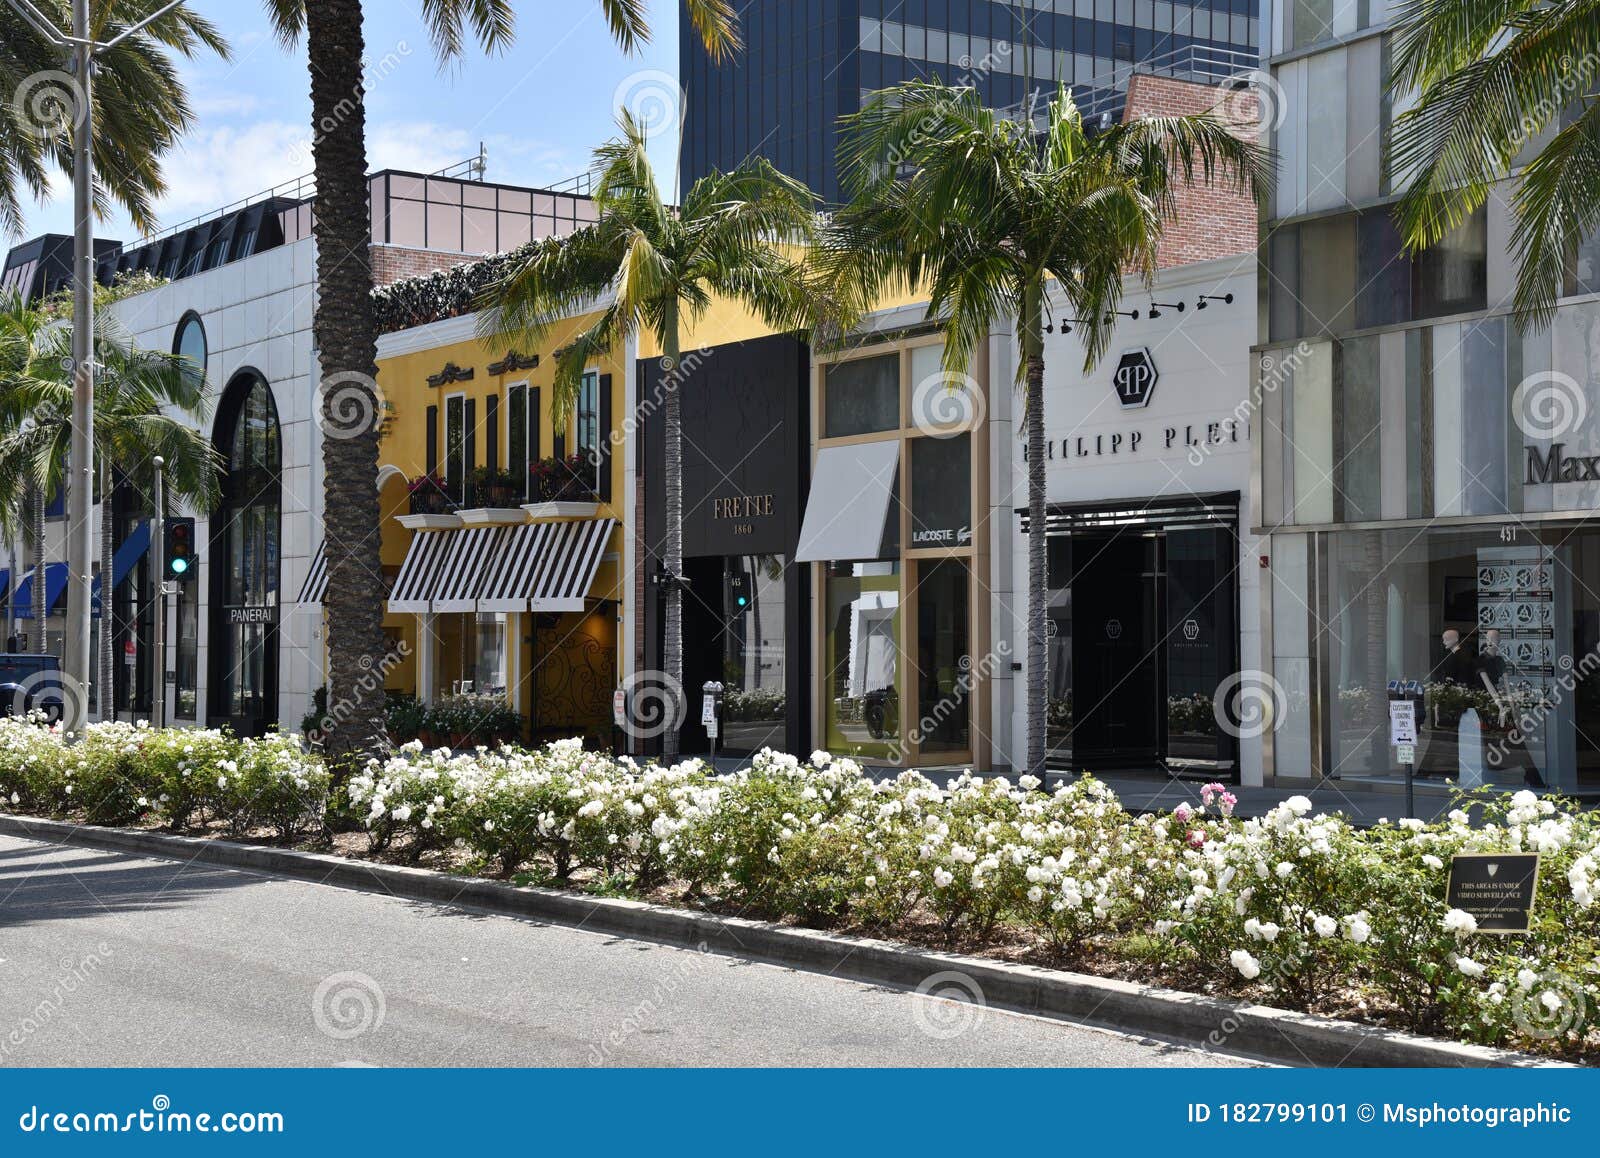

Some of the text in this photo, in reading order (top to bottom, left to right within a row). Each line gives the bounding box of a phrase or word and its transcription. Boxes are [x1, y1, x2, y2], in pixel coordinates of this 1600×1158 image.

[1164, 422, 1251, 449] PLEI
[1522, 443, 1600, 485] Max
[713, 494, 774, 519] FRETTE
[734, 524, 752, 534] 1860
[913, 529, 954, 542] LACOSTE
[1500, 526, 1516, 542] 451
[230, 608, 272, 622] PANERAI
